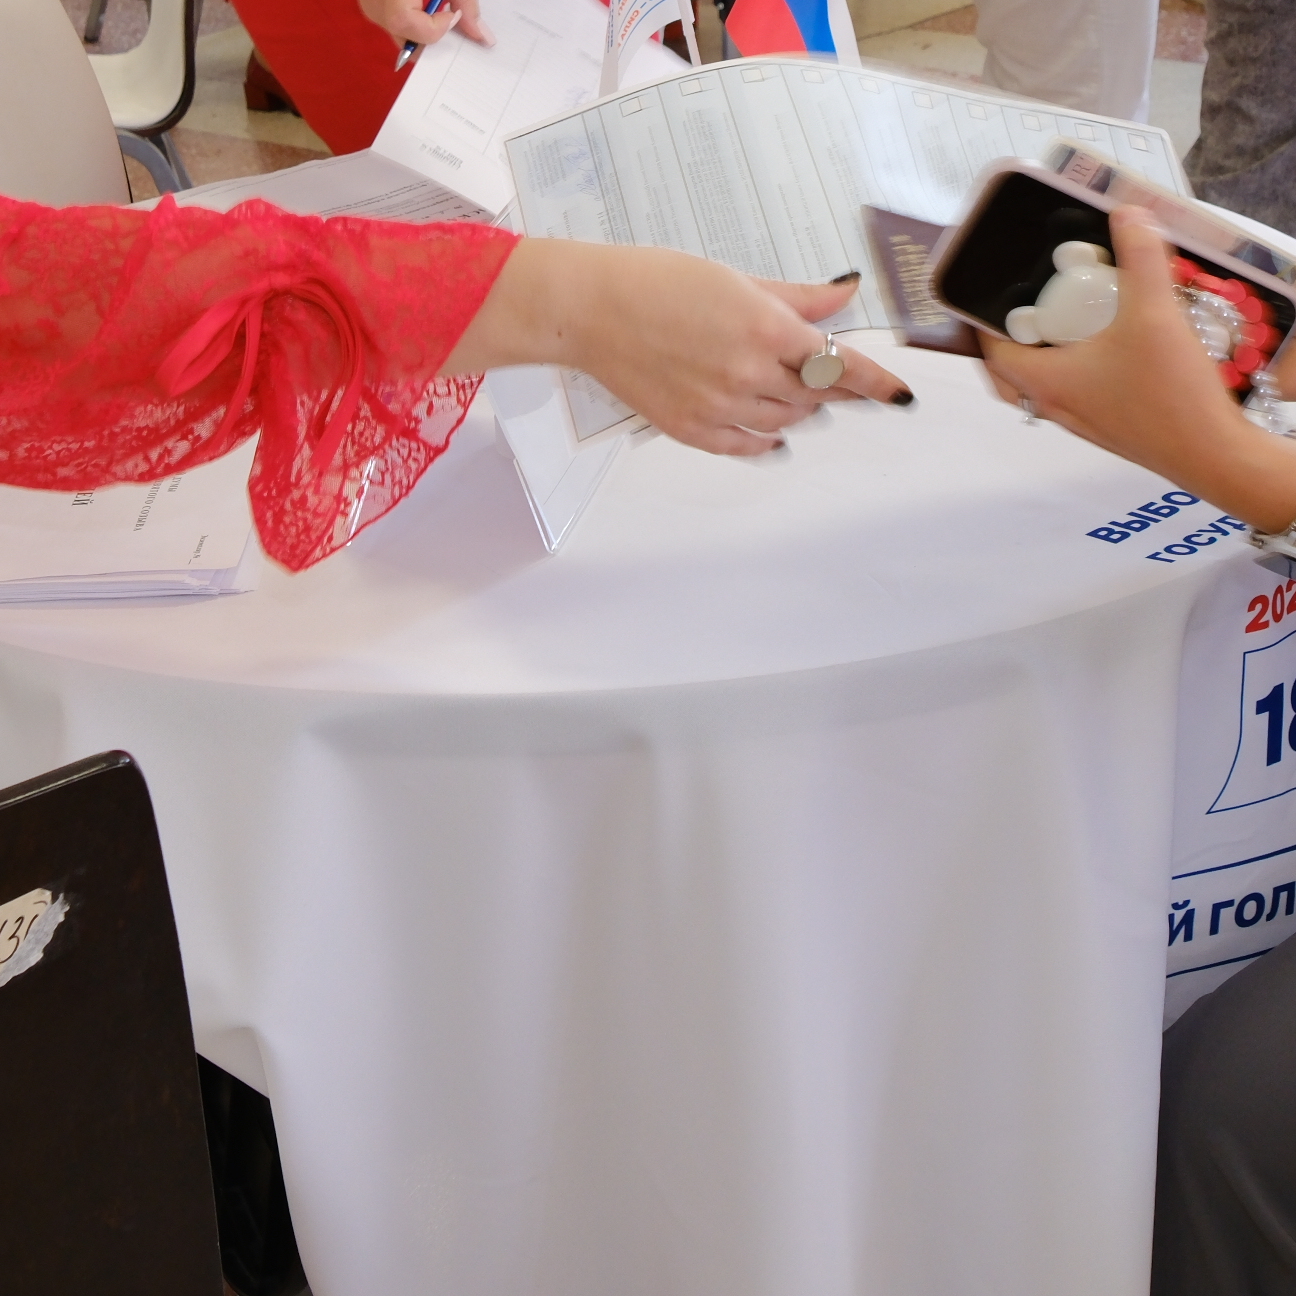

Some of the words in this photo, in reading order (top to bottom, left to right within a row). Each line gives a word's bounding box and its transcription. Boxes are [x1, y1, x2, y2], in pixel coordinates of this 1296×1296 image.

[1085, 490, 1202, 545] ВЫБО
[1145, 515, 1248, 564] ГОСУД
[1167, 899, 1196, 947] Й
